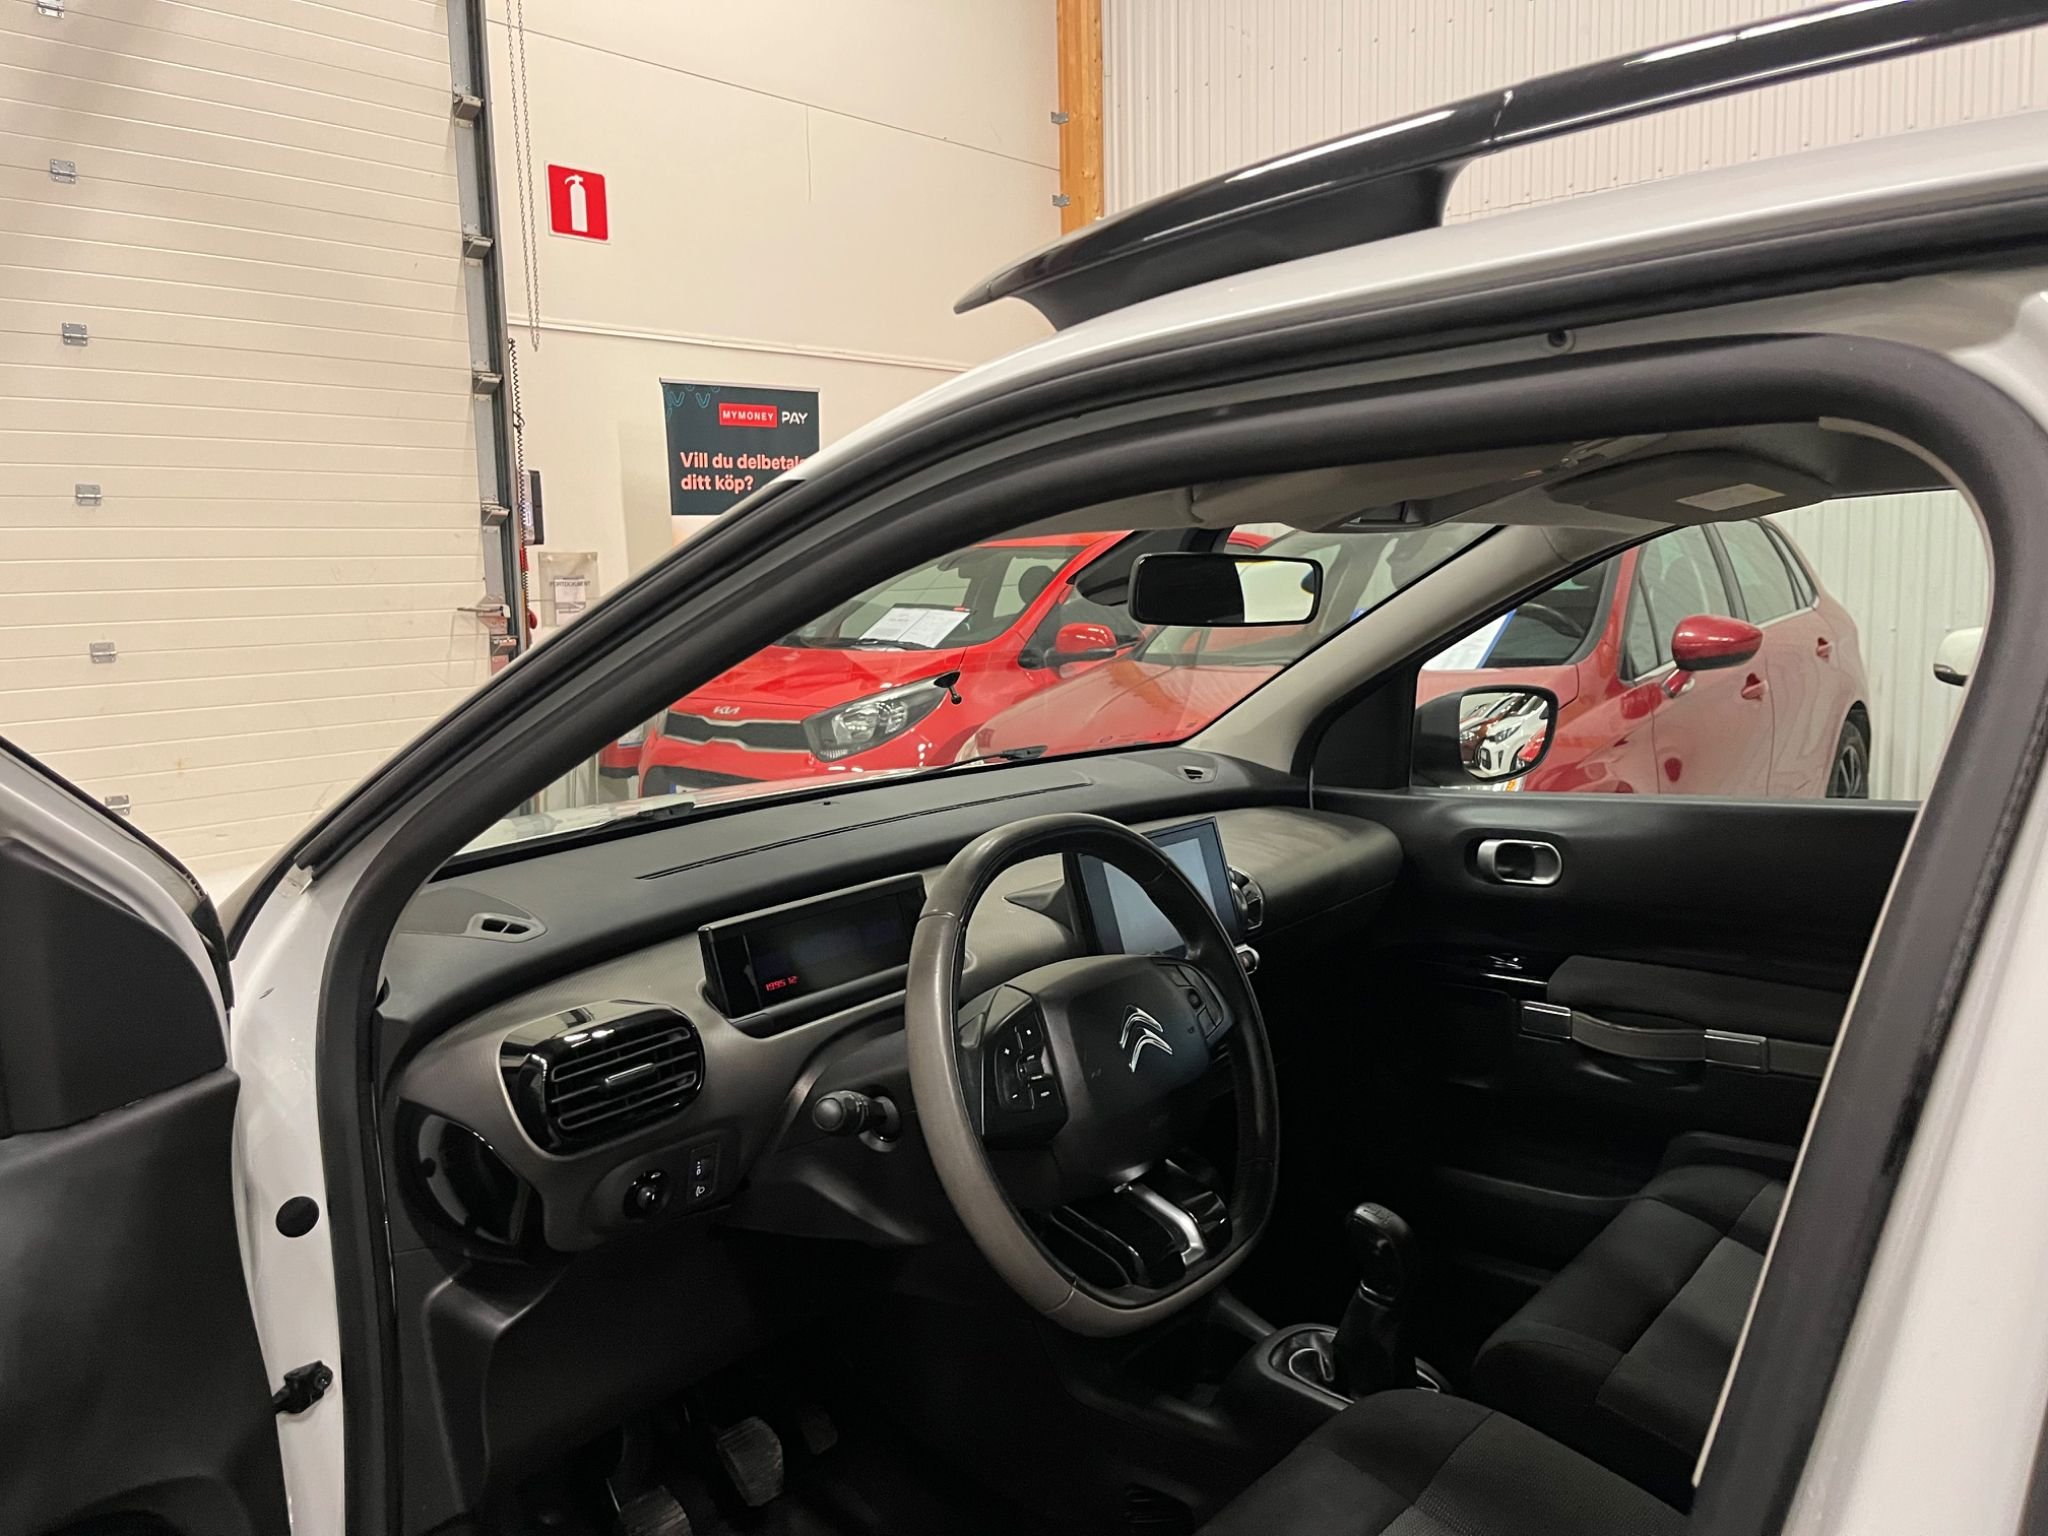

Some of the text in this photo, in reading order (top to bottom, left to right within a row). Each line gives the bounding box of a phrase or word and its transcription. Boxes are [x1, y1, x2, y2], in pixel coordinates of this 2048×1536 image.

[722, 410, 808, 424] MYMONEY PAY
[680, 452, 806, 470] Vill du delbetal
[681, 474, 754, 494] ditt köp?
